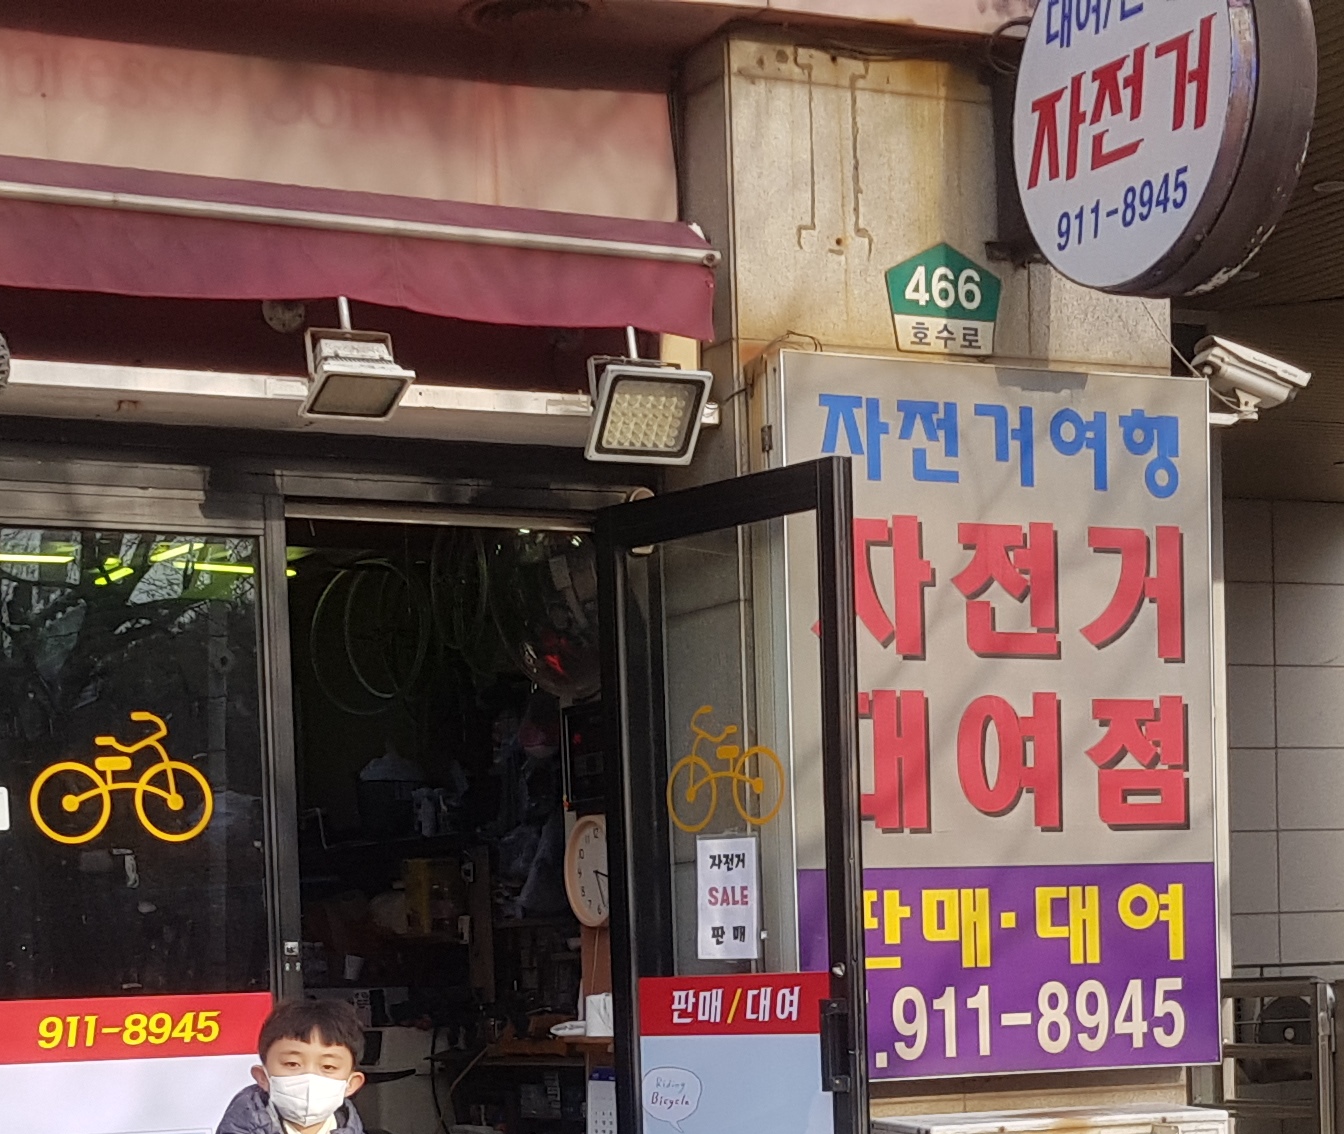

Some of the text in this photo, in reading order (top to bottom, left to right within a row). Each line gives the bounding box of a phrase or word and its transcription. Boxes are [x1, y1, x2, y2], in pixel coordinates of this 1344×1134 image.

[1045, 0, 1145, 48] 대여/
[1027, 13, 1217, 190] 자전거
[1056, 165, 1188, 251] 911-8945
[904, 266, 982, 309] 466
[910, 321, 982, 350] 호수로
[818, 393, 1179, 499] 자전거여행
[709, 852, 746, 872] 자전거
[707, 885, 749, 906] SALE
[36, 1010, 222, 1050] 911-8945
